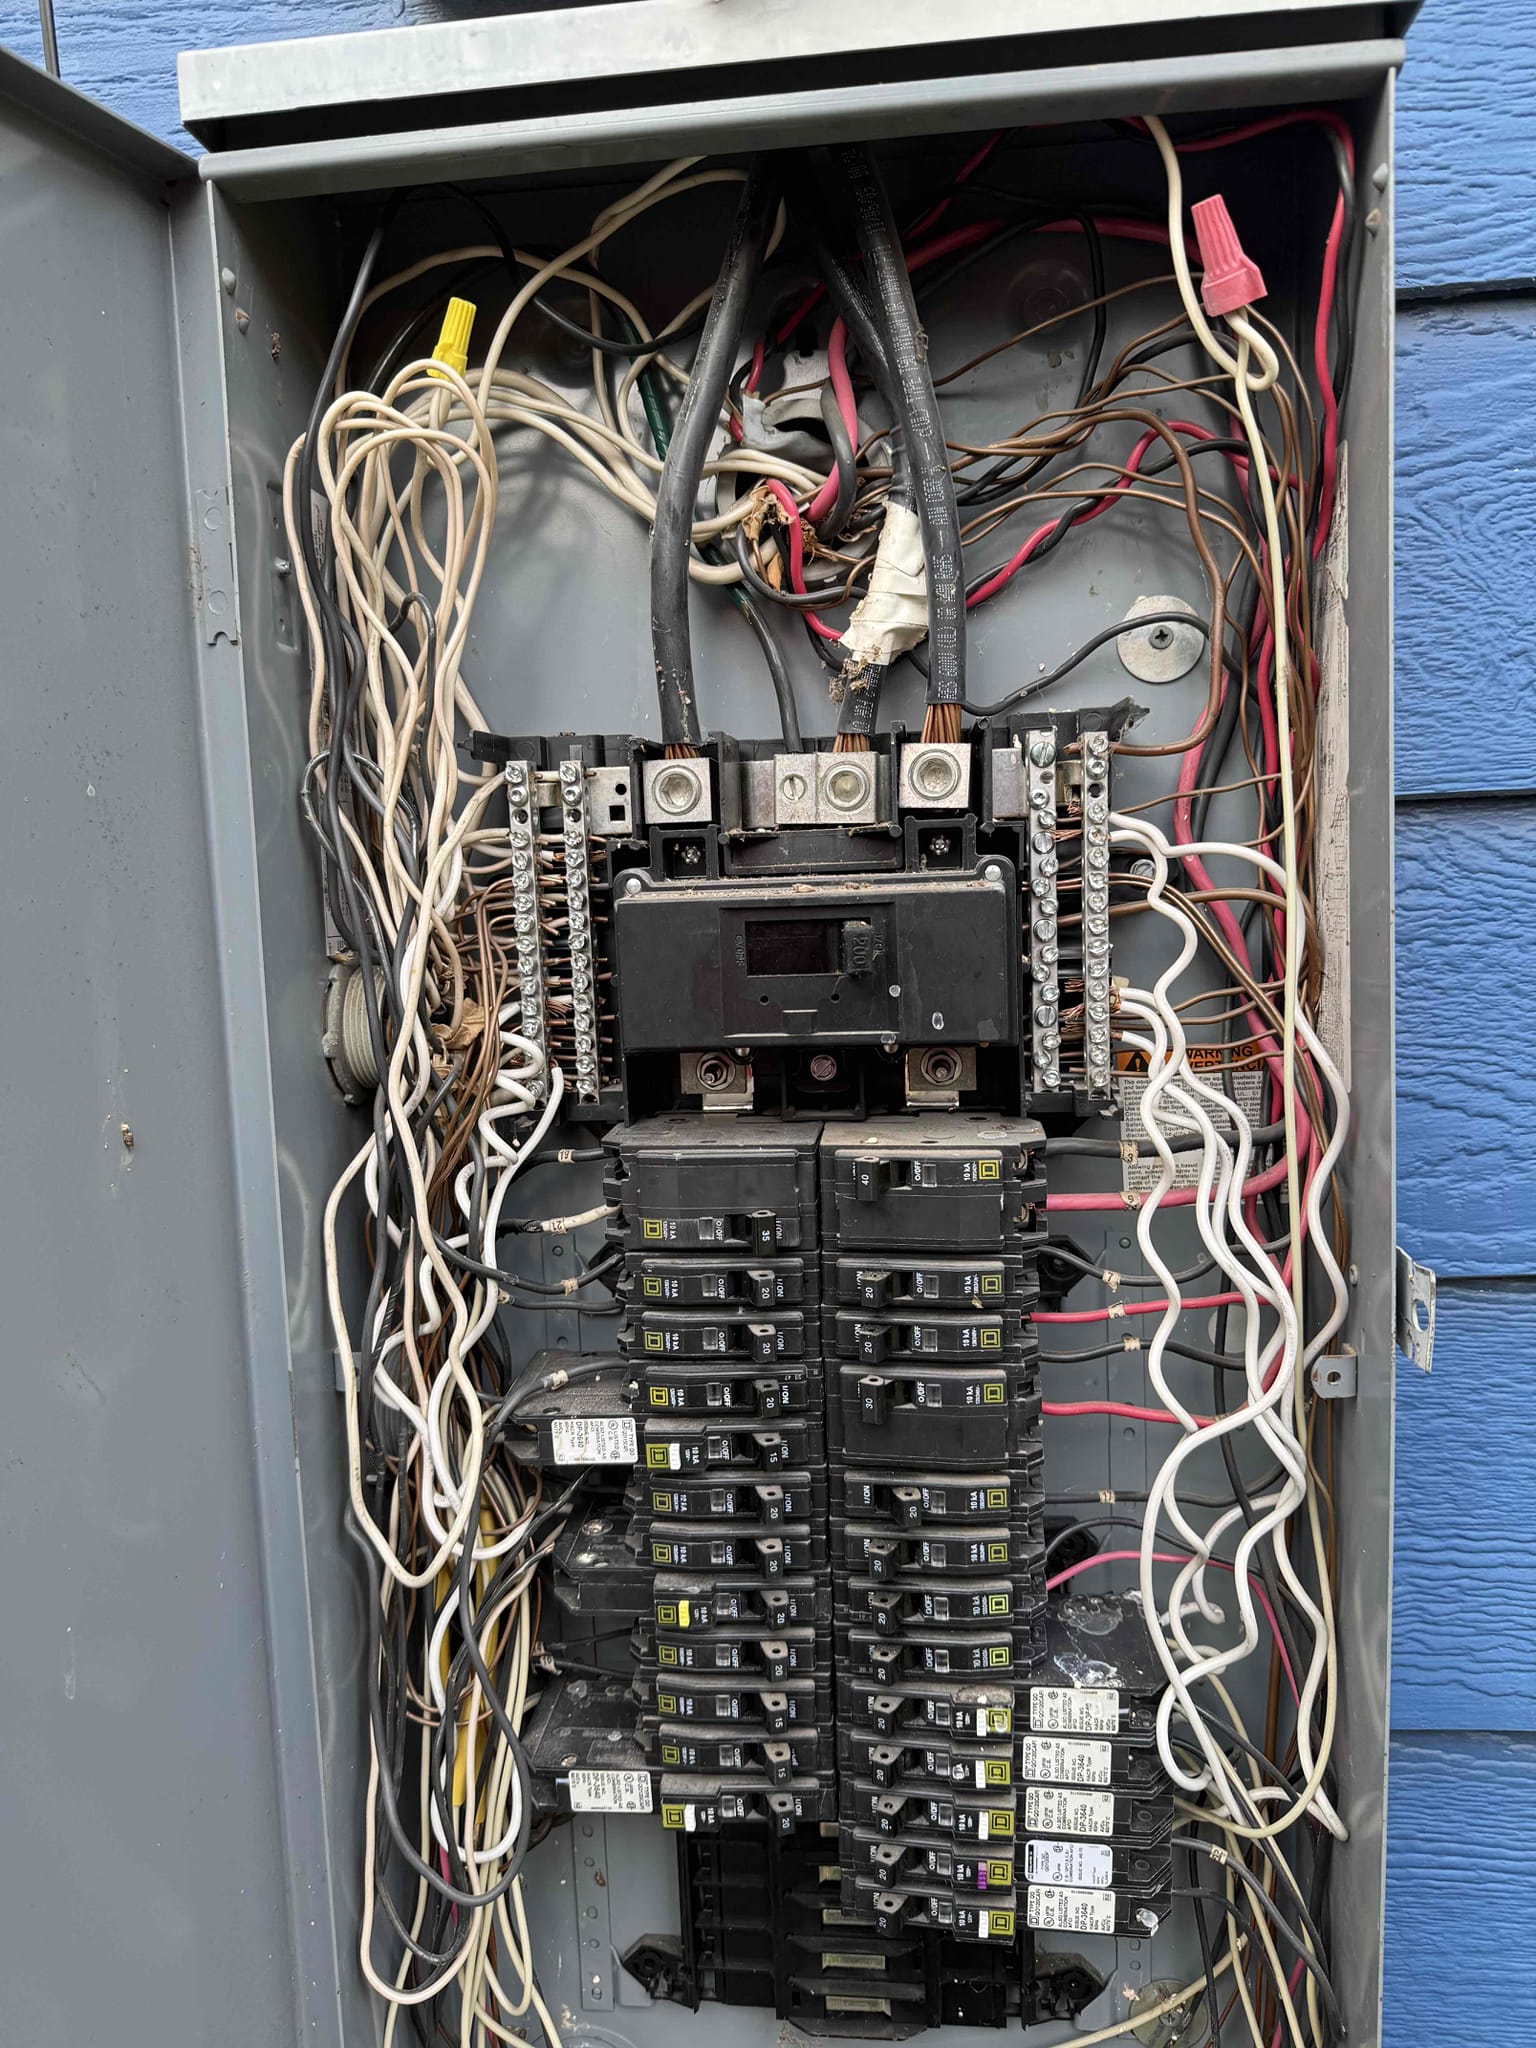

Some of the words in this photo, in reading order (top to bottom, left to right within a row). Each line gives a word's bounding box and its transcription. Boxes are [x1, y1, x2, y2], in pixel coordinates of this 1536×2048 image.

[852, 937, 866, 965] 200
[862, 1174, 869, 1185] 40
[762, 1231, 770, 1241] 35
[761, 1288, 769, 1299] 20
[866, 1287, 873, 1298] 20
[763, 1343, 770, 1354] 20
[865, 1342, 872, 1353] 20
[766, 1398, 774, 1409] 20
[866, 1398, 873, 1409] 30
[769, 1453, 777, 1462] 15
[770, 1508, 778, 1518] 20
[910, 1507, 917, 1518] 20
[769, 1561, 777, 1571] 20
[874, 1560, 881, 1571] 20
[777, 1613, 785, 1624] 20
[879, 1613, 885, 1624] 20
[775, 1665, 783, 1675] 20
[879, 1669, 885, 1680] 20
[775, 1718, 783, 1727] 15
[878, 1718, 885, 1729] 20
[877, 1769, 884, 1780] 20
[782, 1818, 789, 1828] 20
[881, 1819, 889, 1830] 20
[879, 1869, 886, 1880] 20
[879, 1917, 887, 1928] 20
